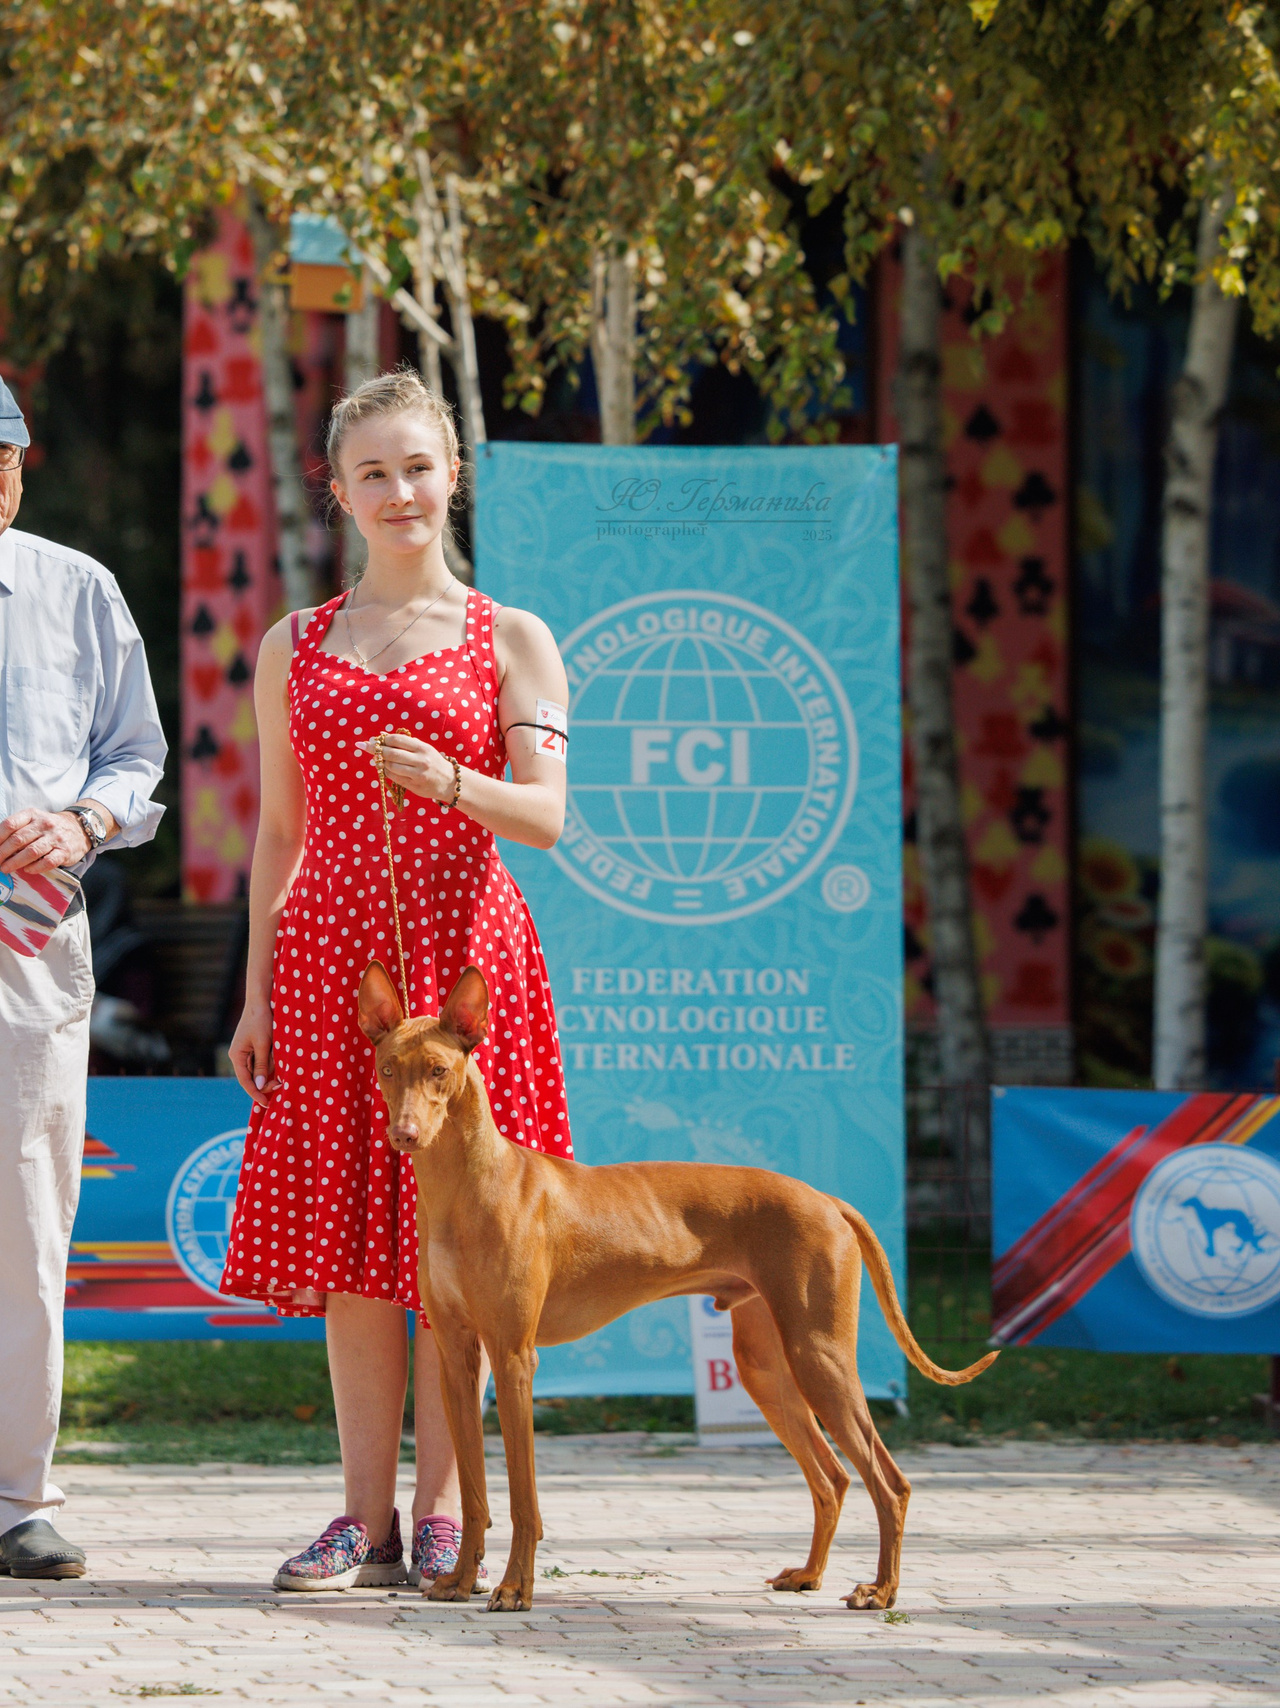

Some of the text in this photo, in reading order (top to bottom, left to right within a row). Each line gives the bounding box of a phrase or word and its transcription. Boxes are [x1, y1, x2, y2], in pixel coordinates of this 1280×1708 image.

[629, 727, 751, 786] FCI
[722, 644, 842, 900] INTERNATIONALE
[571, 966, 811, 996] FEDERATION
[556, 1005, 829, 1036] CYNOLOGIQUE
